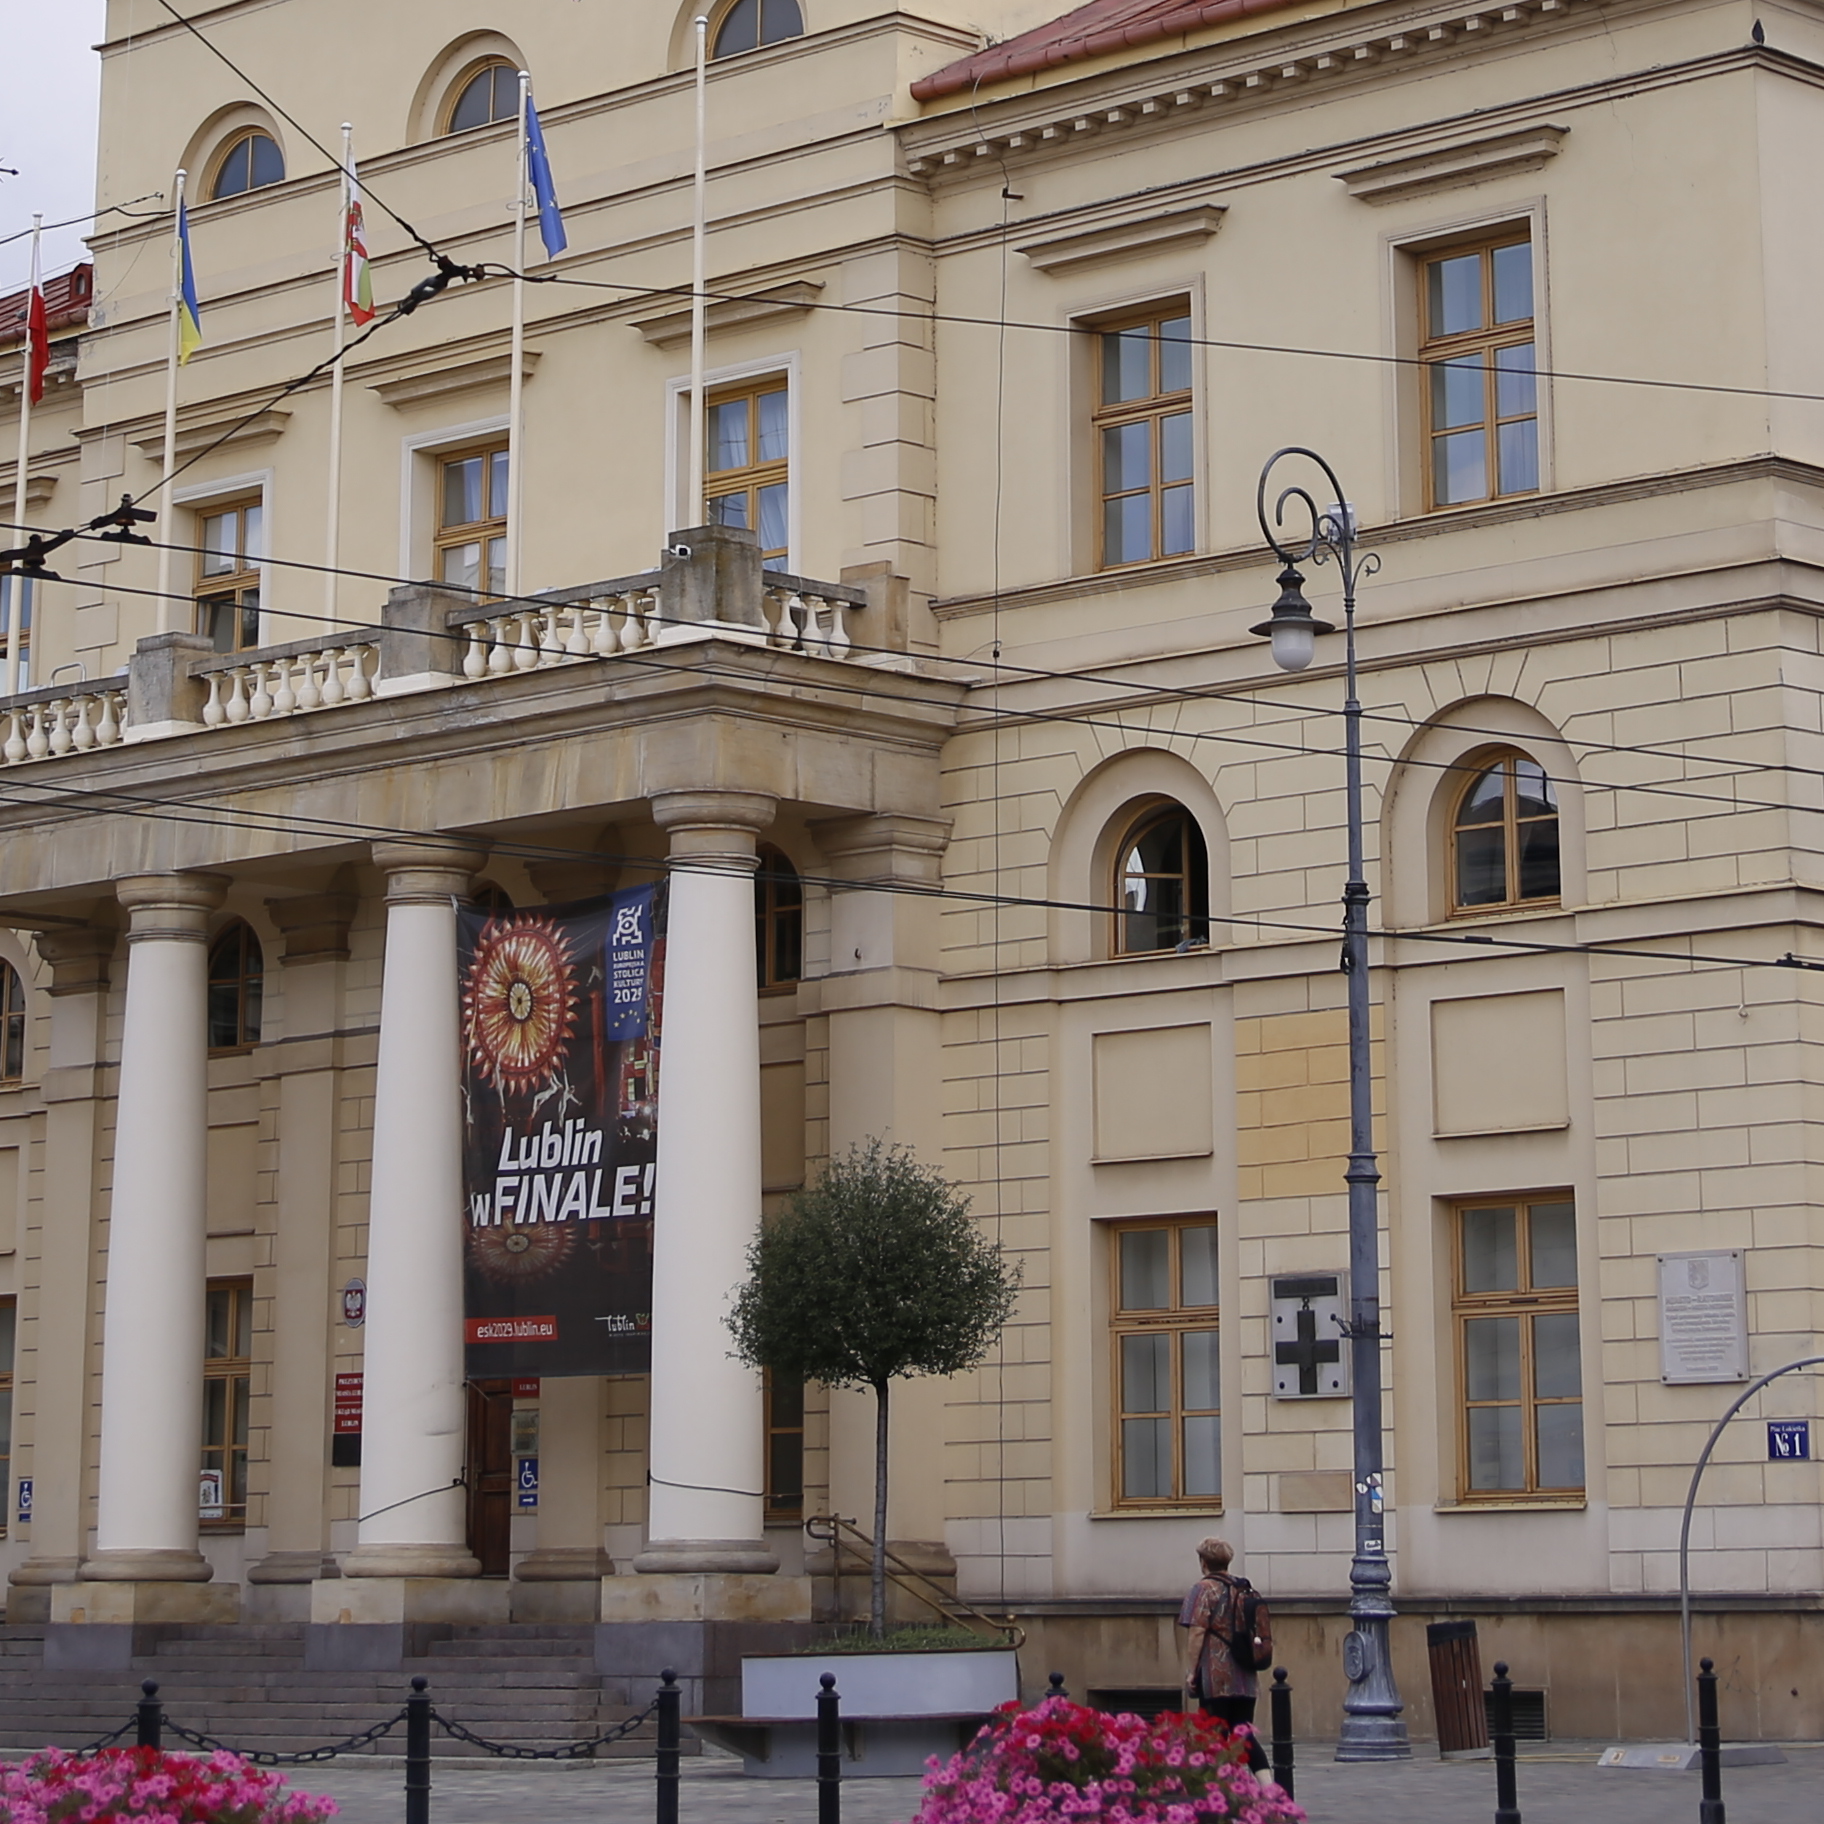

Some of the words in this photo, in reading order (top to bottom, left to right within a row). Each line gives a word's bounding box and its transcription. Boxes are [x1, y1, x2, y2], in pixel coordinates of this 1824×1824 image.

[612, 949, 645, 962] LUBLIN
[613, 968, 645, 980] STOLICA
[613, 978, 644, 988] KULTURY
[614, 987, 643, 1004] 2029
[497, 1117, 603, 1171] Lublin
[477, 1321, 553, 1338] esk2029.lublin.eu
[1793, 1433, 1802, 1456] 1
